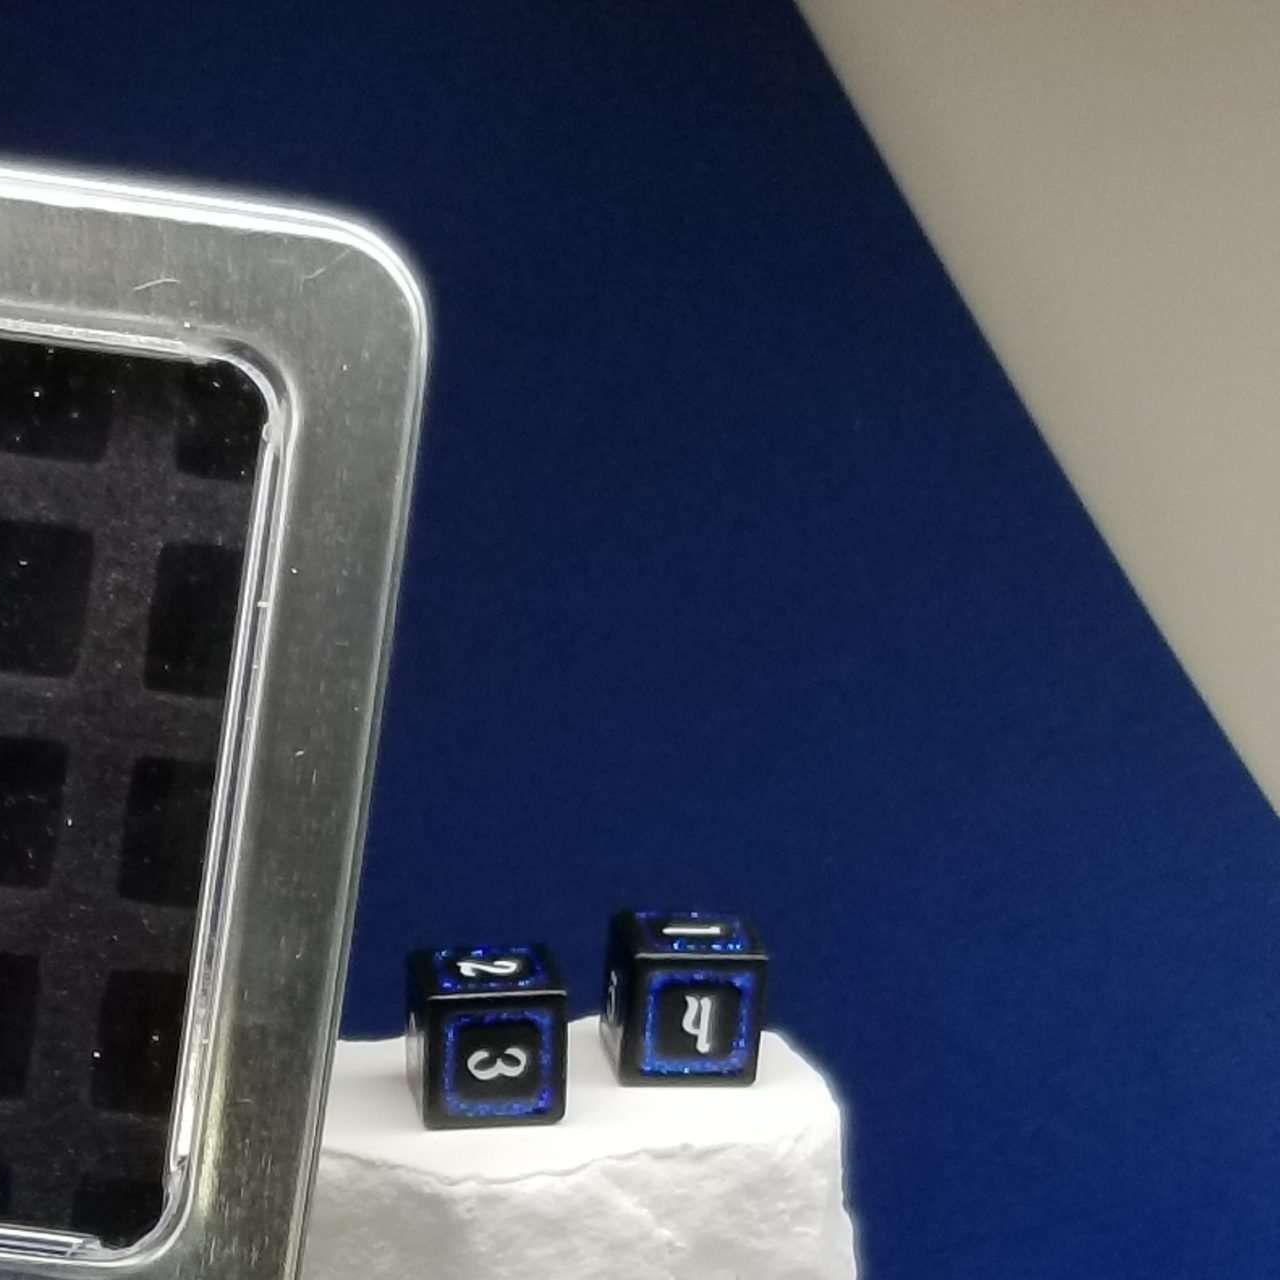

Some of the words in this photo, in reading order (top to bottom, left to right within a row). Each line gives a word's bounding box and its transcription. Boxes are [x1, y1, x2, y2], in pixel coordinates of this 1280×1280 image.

[662, 925, 721, 935] 1
[457, 960, 518, 977] 2
[682, 995, 713, 1054] 4
[467, 1047, 527, 1081] 3
